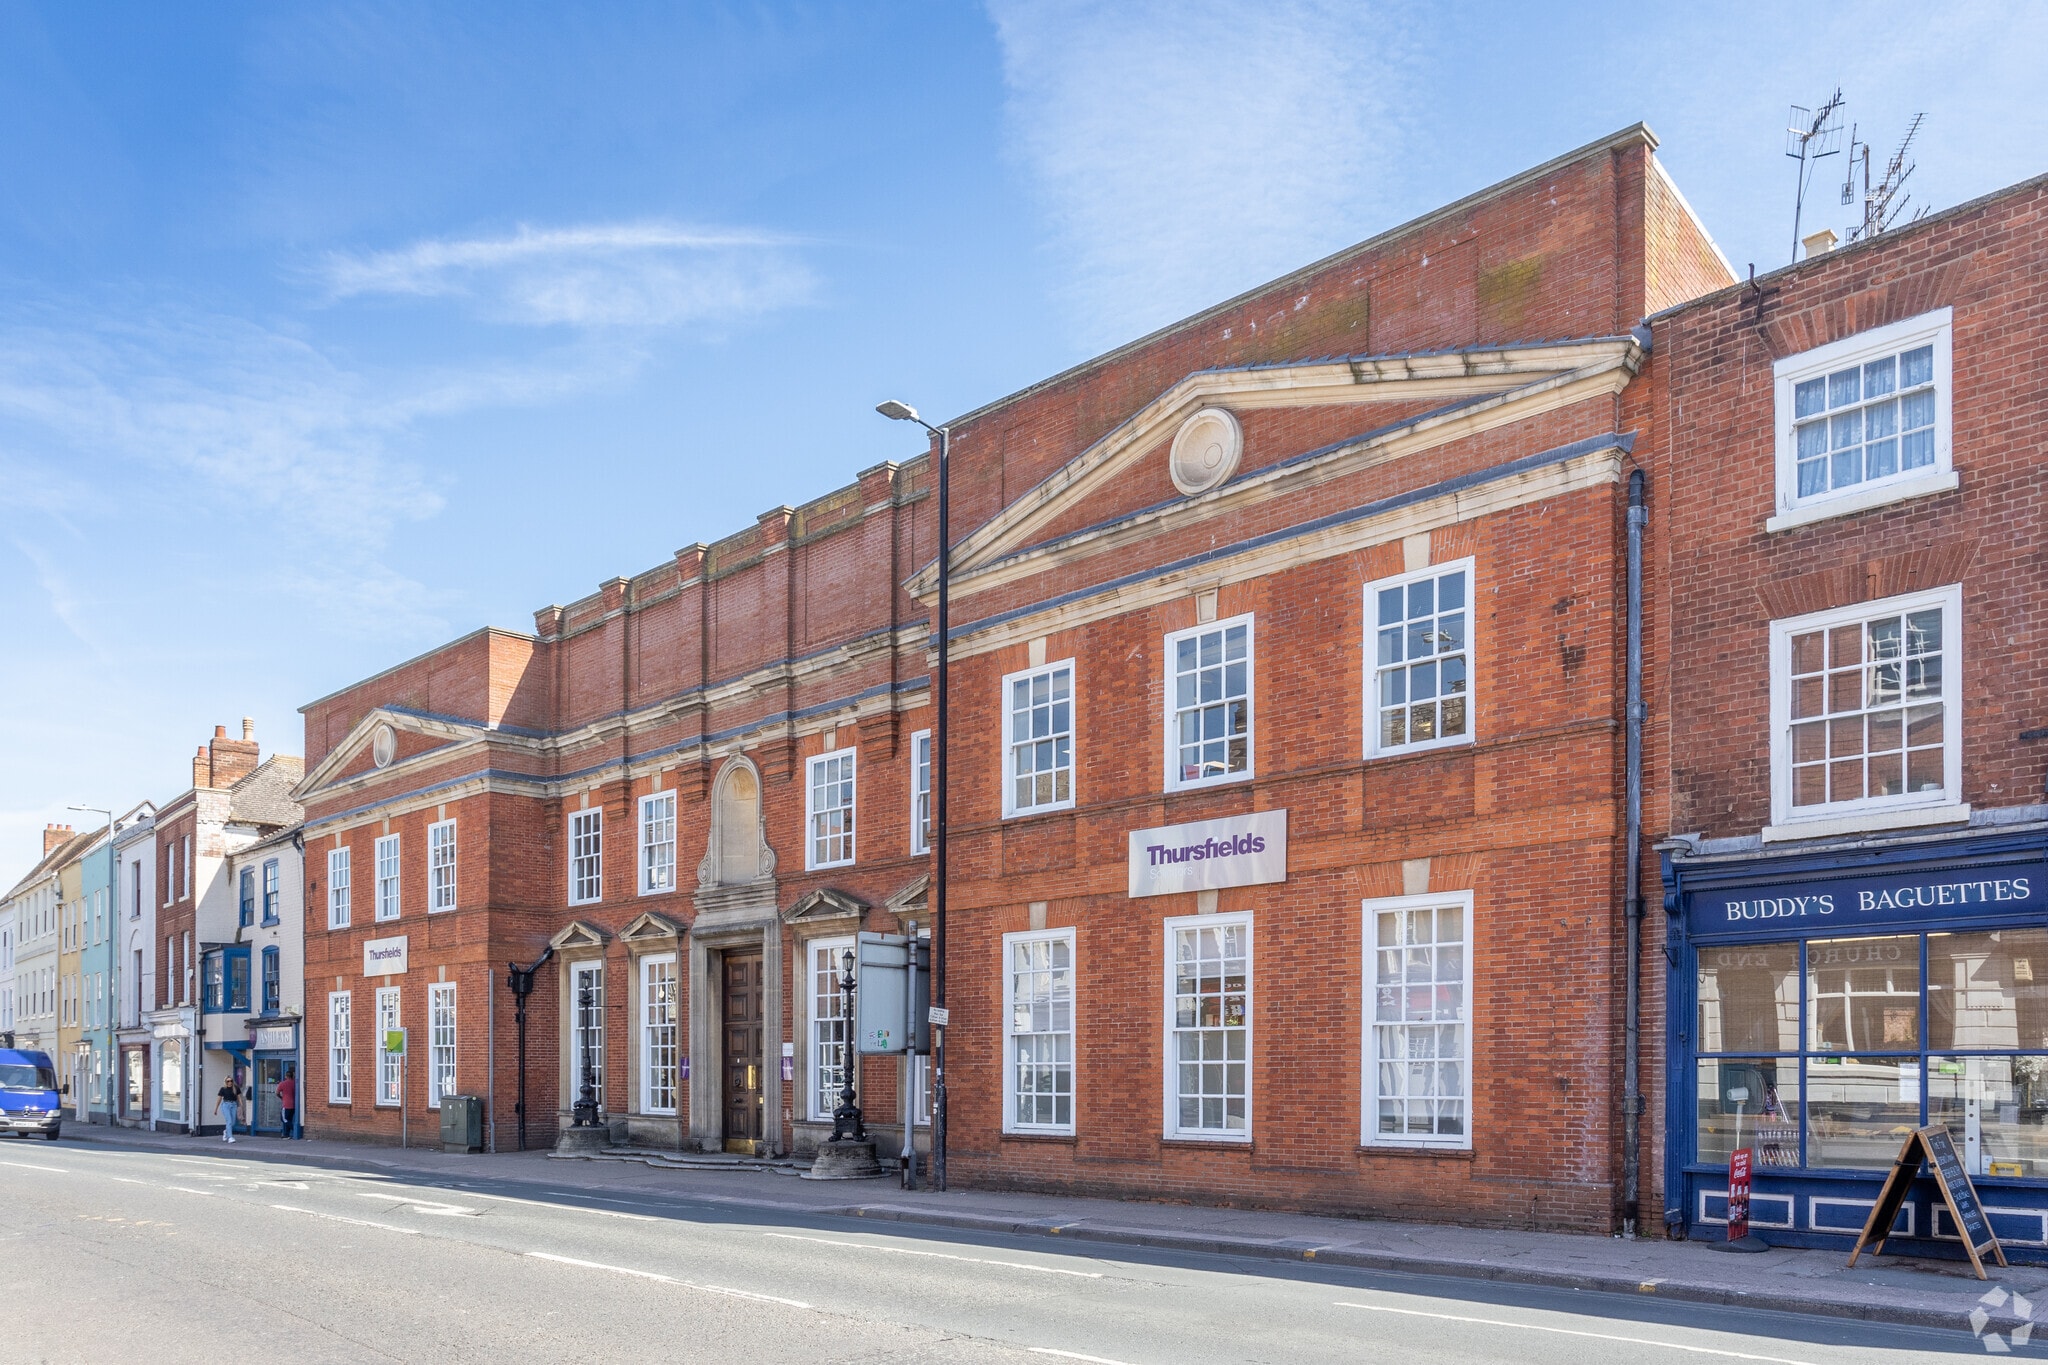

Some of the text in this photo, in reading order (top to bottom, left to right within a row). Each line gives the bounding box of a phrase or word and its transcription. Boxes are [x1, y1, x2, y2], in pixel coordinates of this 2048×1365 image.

[1147, 833, 1266, 866] Thursfields
[1725, 878, 2031, 921] BUDDY'S BAGUETTES
[369, 947, 401, 960] Thursfields
